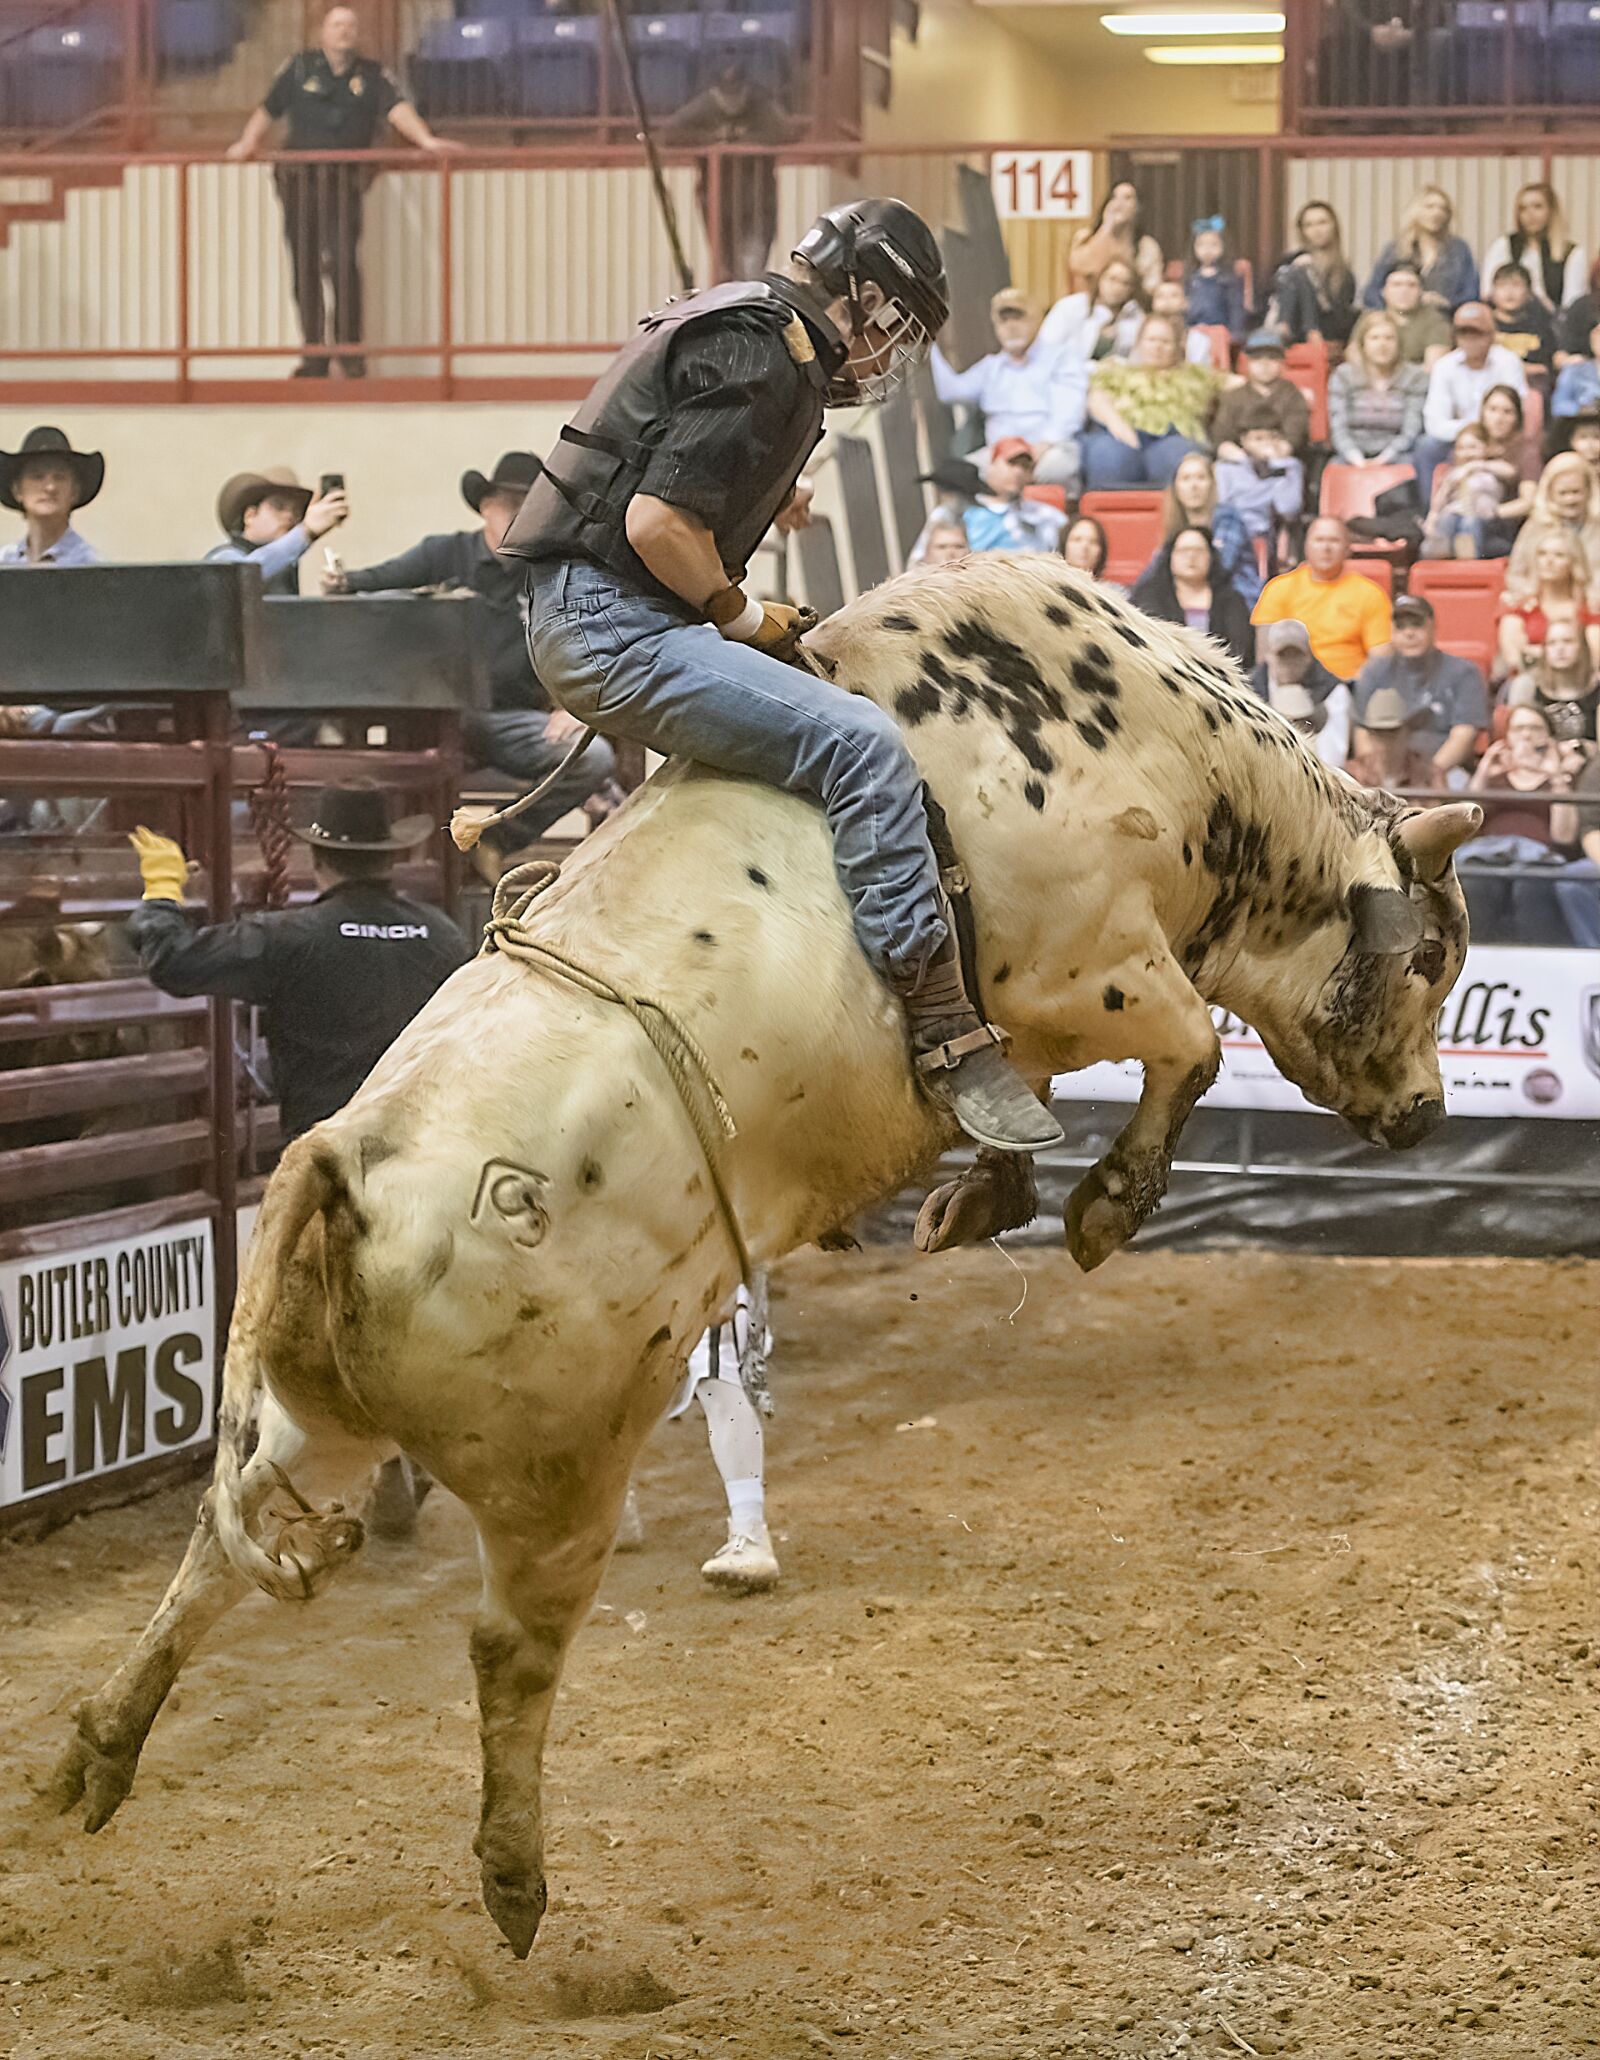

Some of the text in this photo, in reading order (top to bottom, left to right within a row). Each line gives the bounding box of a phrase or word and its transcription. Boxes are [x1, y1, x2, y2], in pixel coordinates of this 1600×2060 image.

[1000, 159, 1078, 211] 114
[18, 1235, 205, 1354] BUTLER COUNTY
[20, 1332, 203, 1493] EMS
